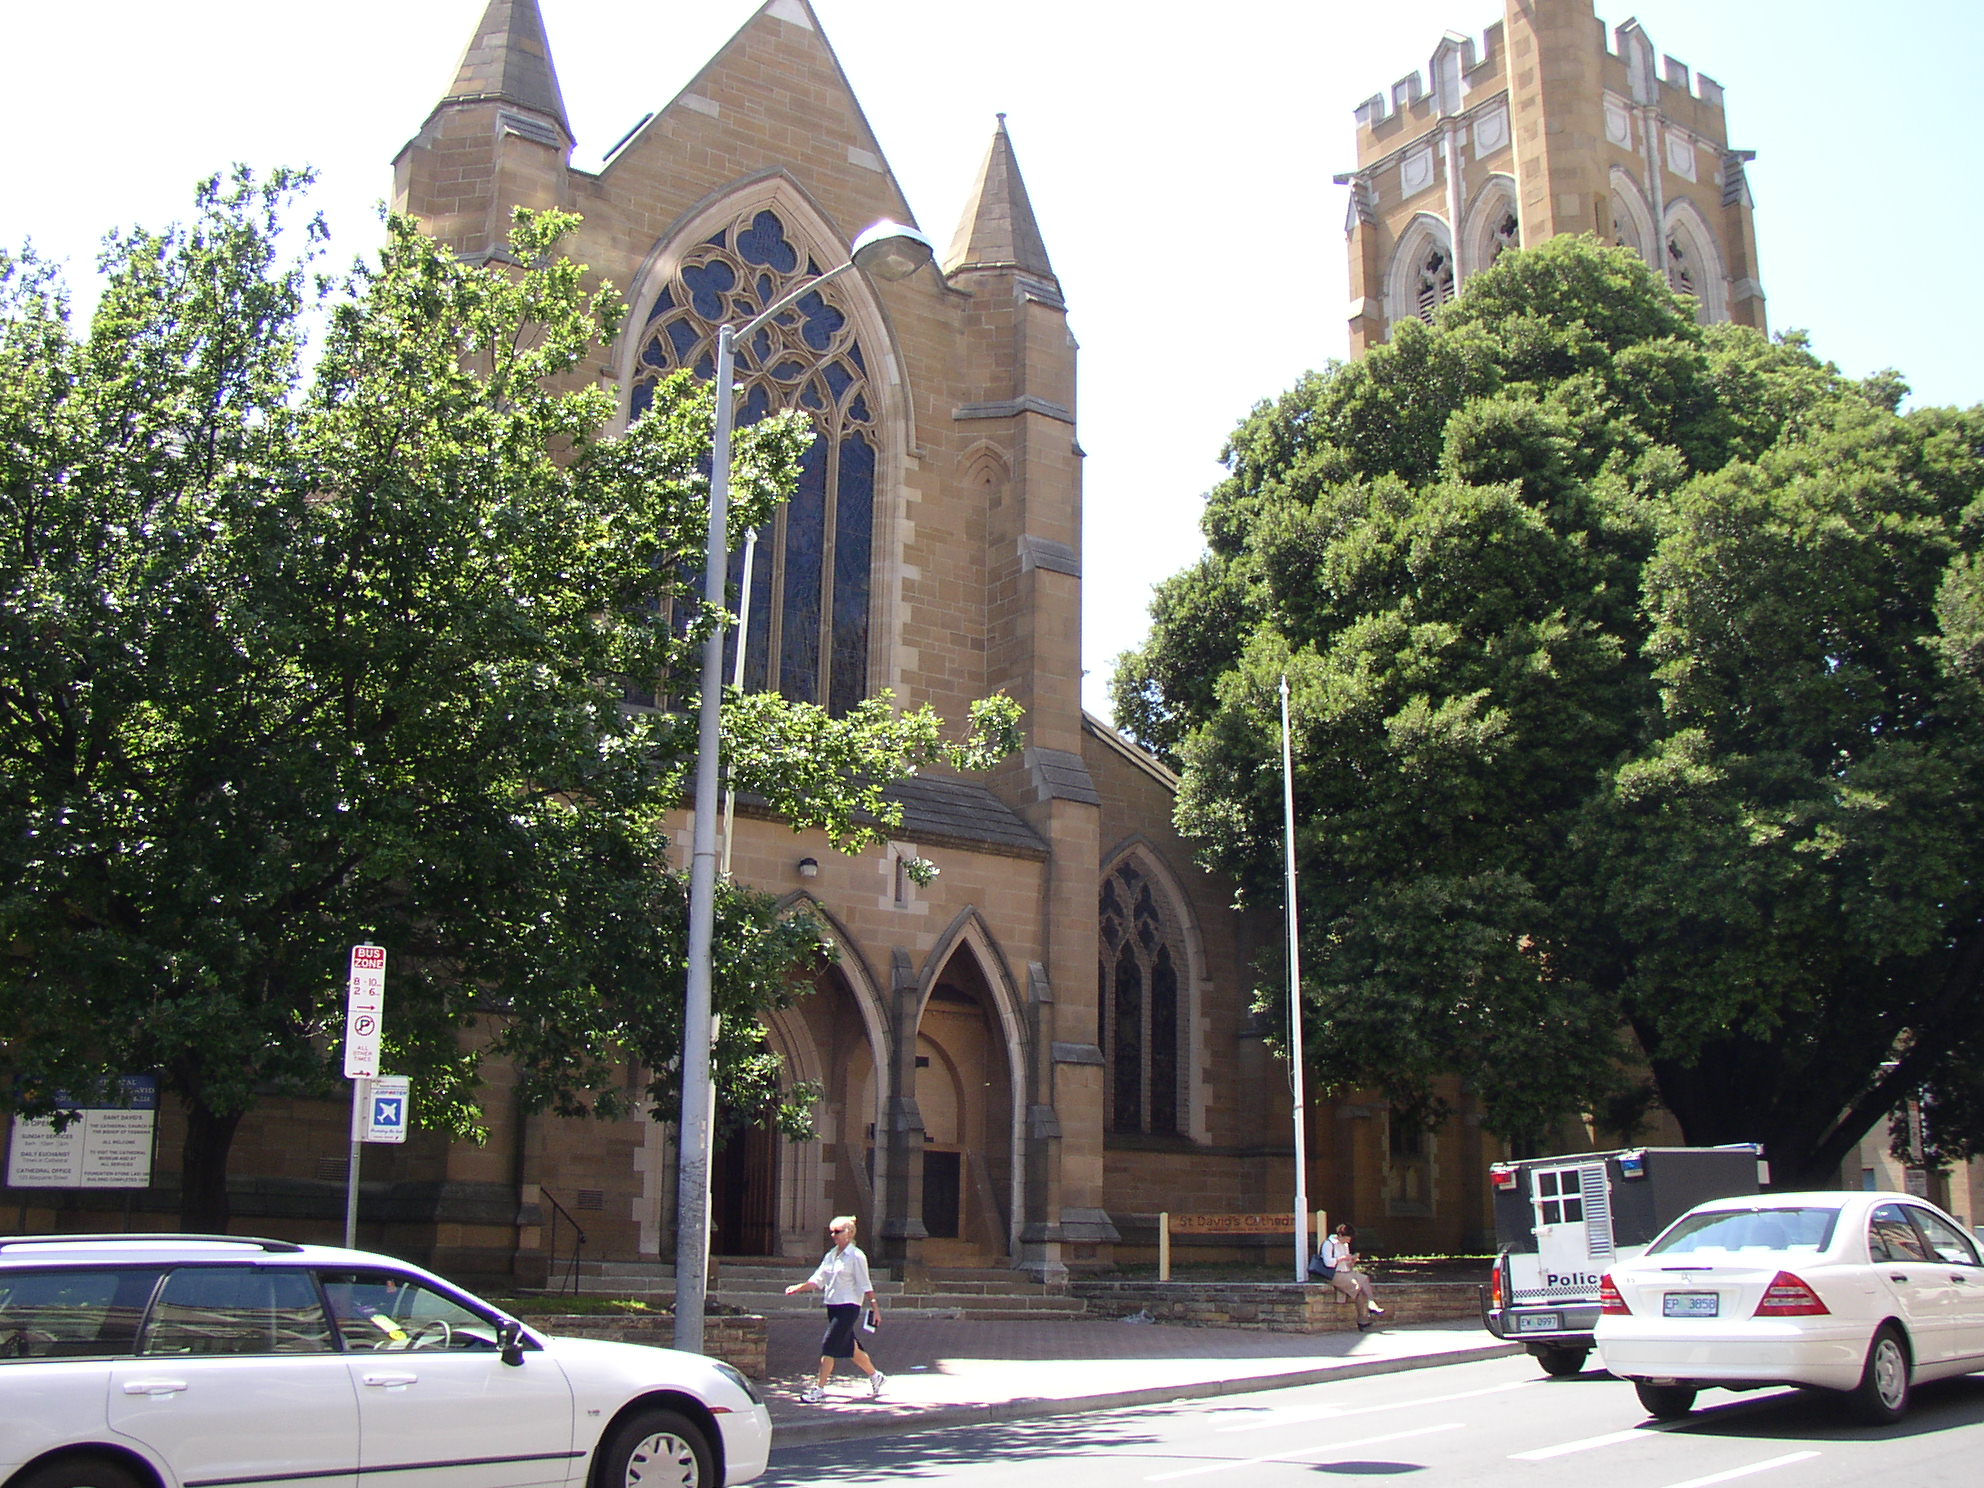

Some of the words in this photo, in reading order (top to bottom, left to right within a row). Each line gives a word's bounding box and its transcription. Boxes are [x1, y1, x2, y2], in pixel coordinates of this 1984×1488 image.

[358, 949, 380, 958] BUS
[354, 959, 384, 969] ZONE
[1180, 1215, 1194, 1226] St
[1198, 1215, 1242, 1227] David's
[1245, 1214, 1296, 1227] Cathedr
[1546, 1272, 1604, 1287] Polic
[1664, 1298, 1679, 1310] EP
